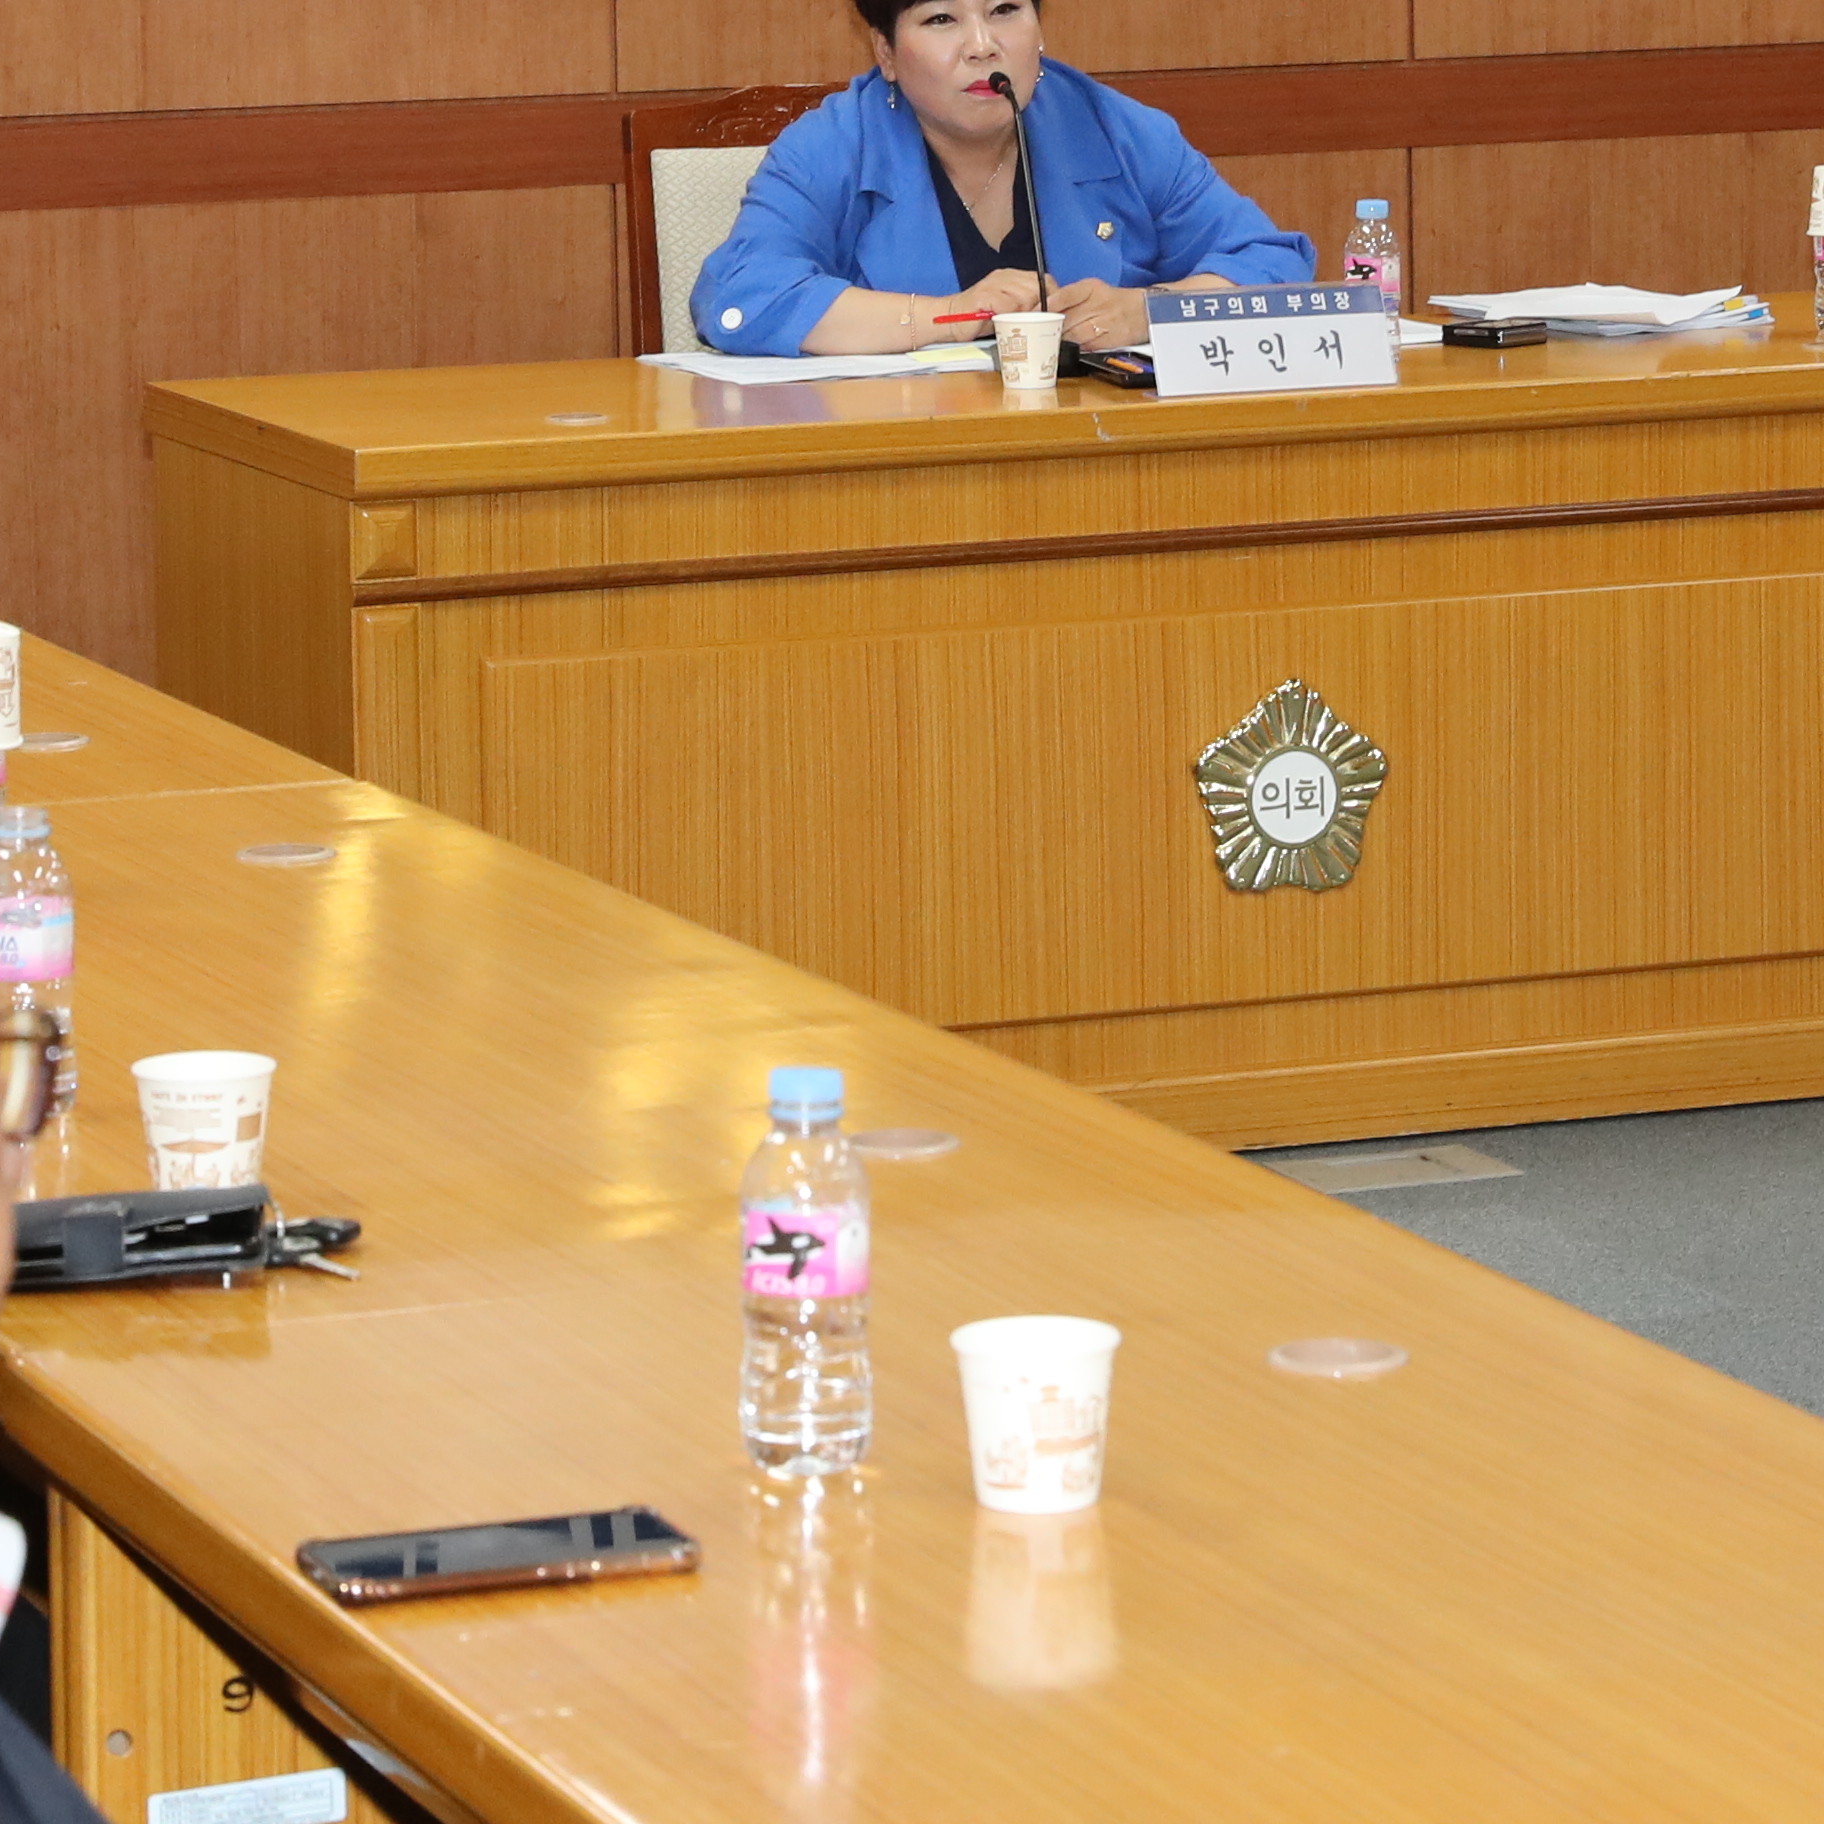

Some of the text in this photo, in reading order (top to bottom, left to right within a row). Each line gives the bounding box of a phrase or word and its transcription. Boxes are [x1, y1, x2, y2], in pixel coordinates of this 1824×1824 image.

[1179, 291, 1351, 318] 남구의회 부의장
[1259, 775, 1326, 820] 의회
